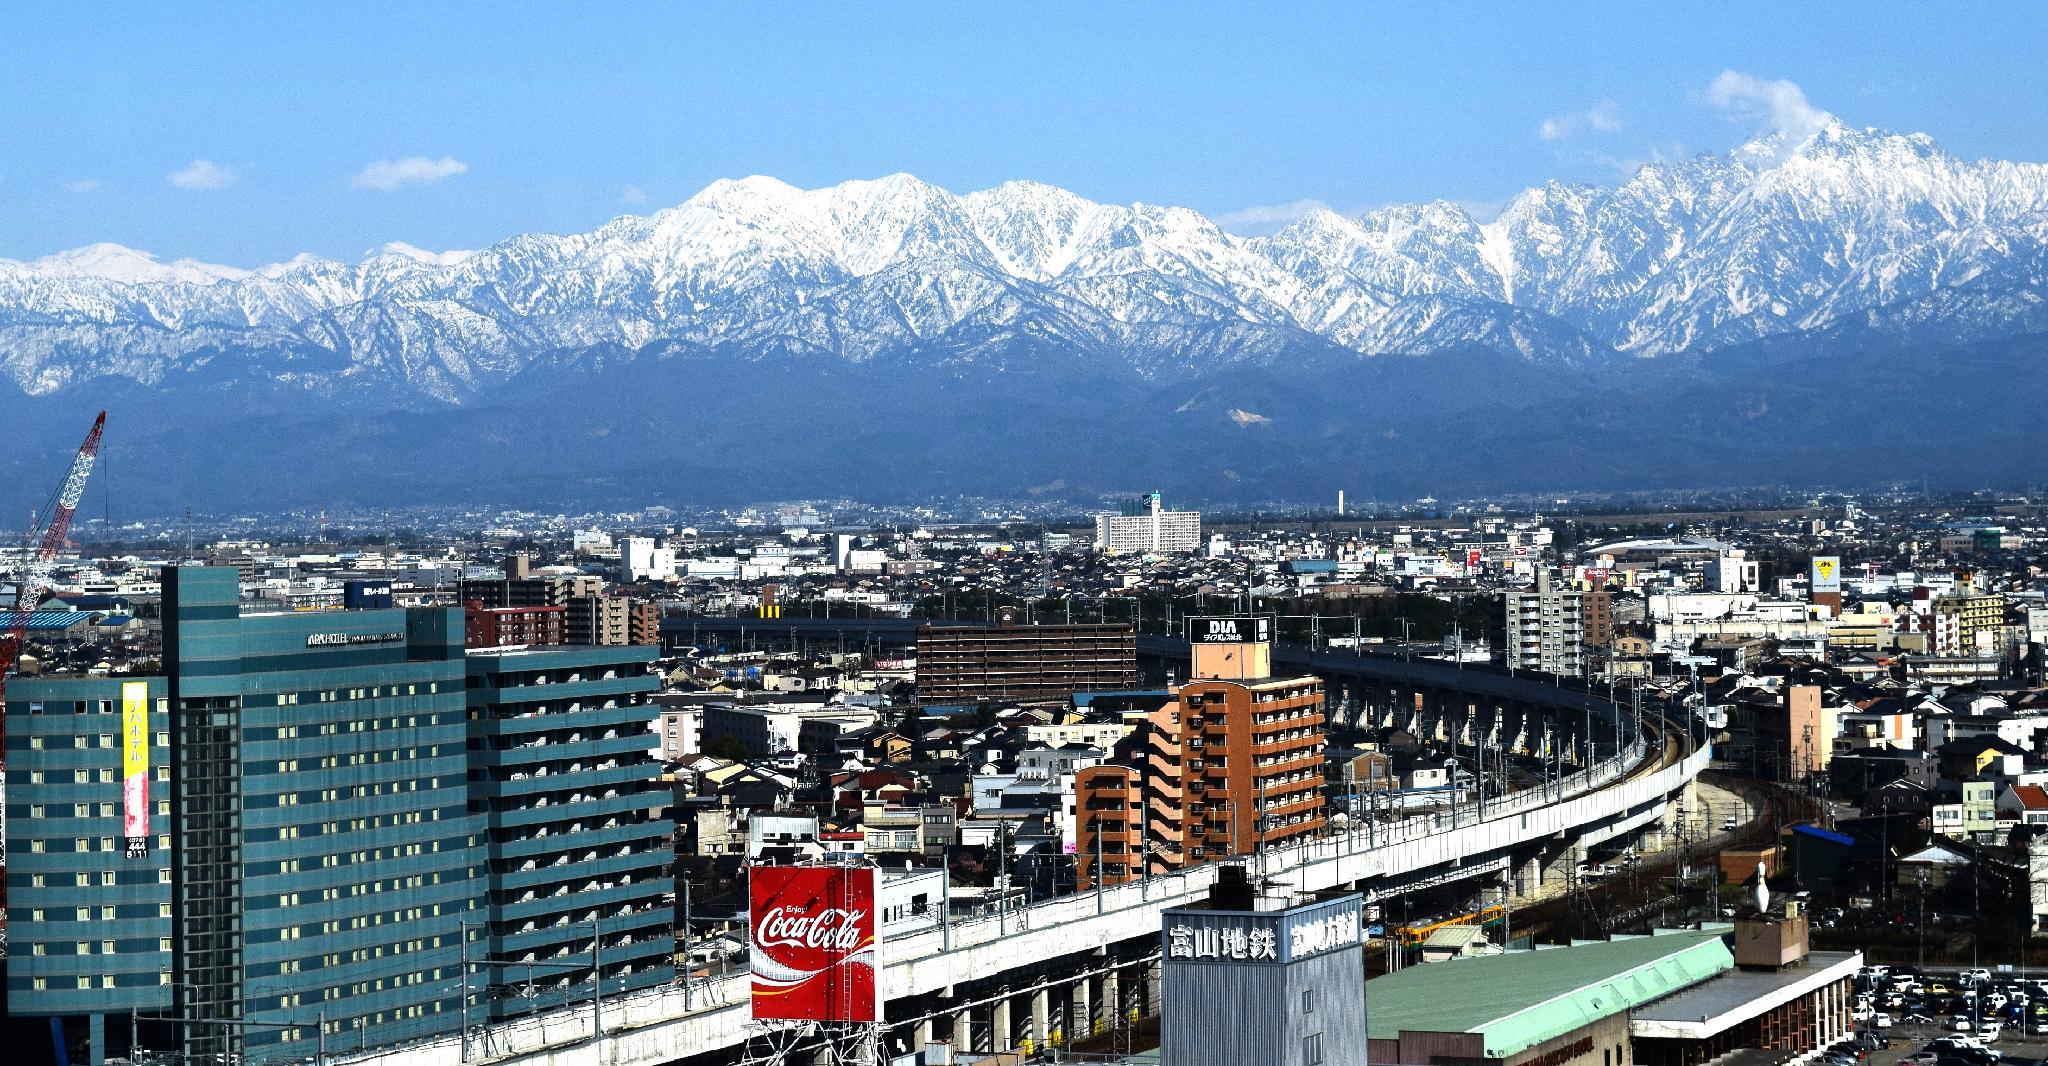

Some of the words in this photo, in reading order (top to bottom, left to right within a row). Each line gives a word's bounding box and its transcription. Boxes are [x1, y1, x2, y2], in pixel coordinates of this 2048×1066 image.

[1209, 620, 1237, 634] DIA
[324, 632, 348, 644] HOTEL
[129, 701, 143, 763] アパホテル
[128, 842, 146, 851] 444
[785, 905, 808, 915] Enjoy!
[757, 907, 868, 949] Coca-Cola
[1169, 924, 1277, 960] 富山地鉄
